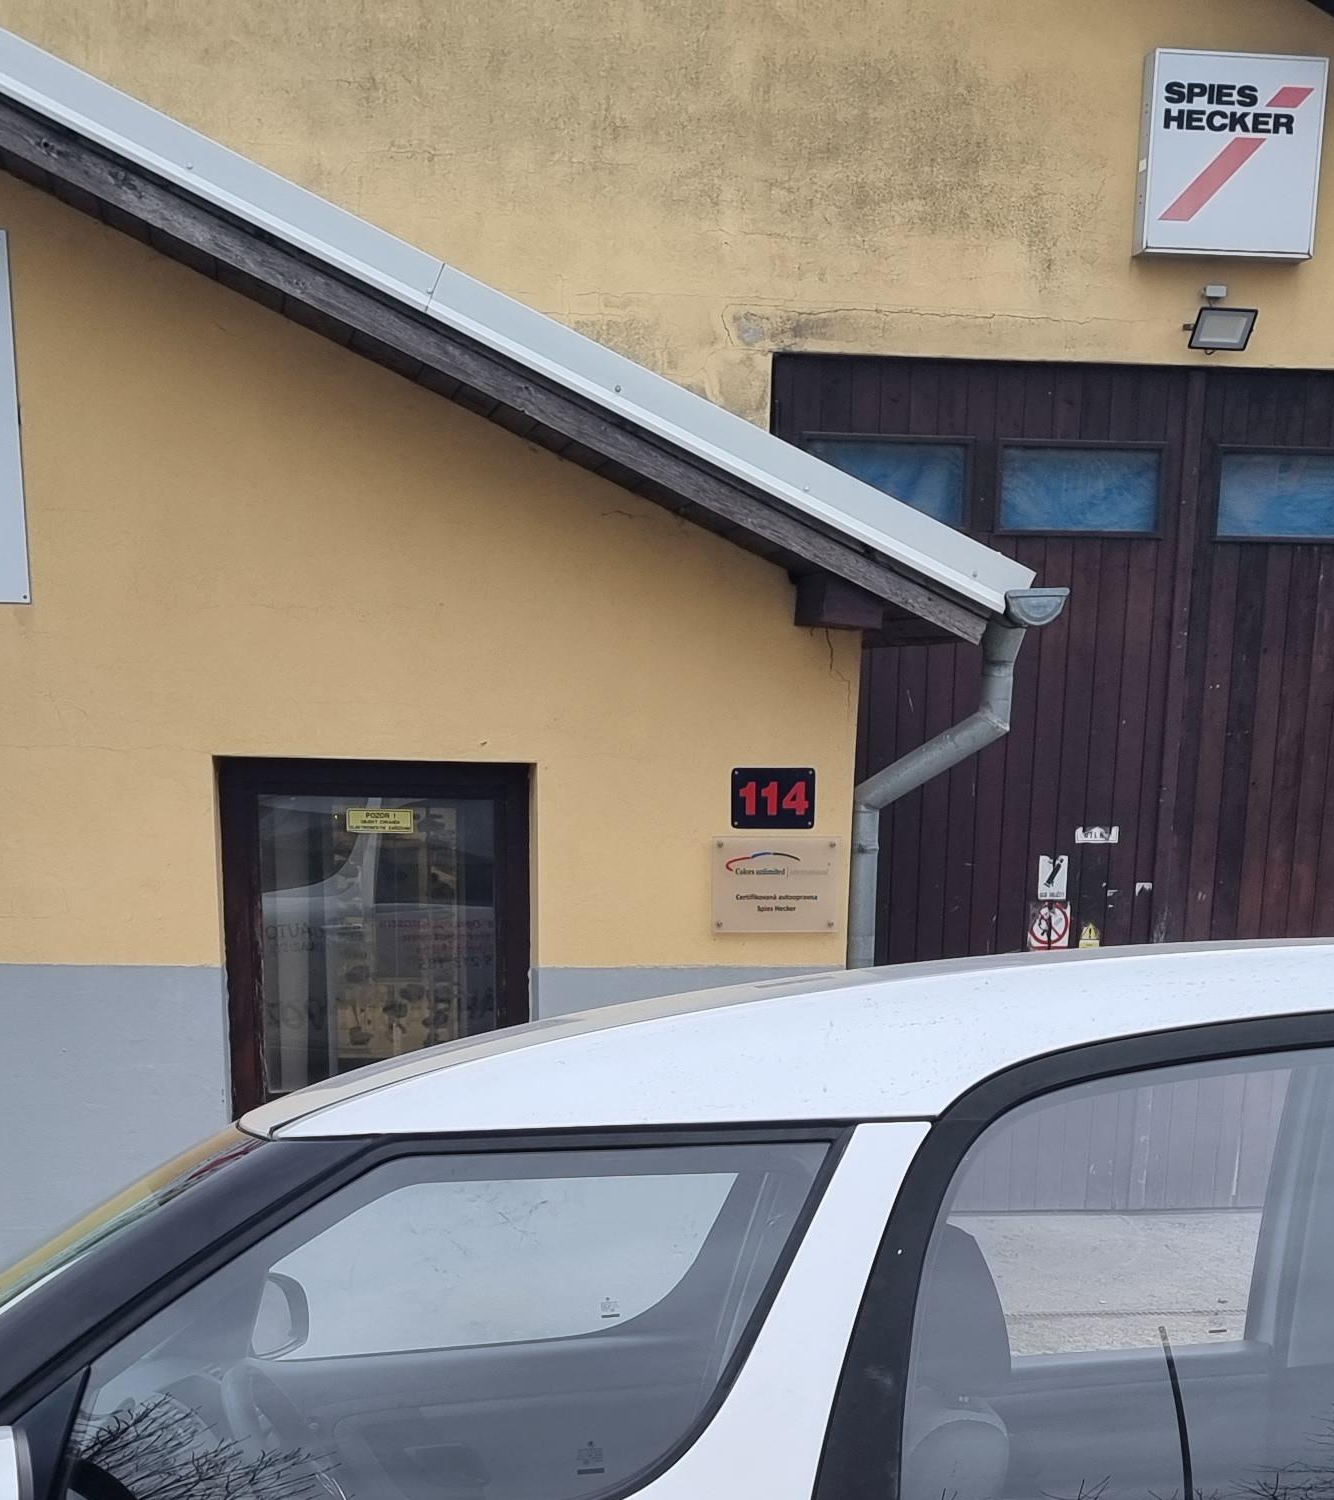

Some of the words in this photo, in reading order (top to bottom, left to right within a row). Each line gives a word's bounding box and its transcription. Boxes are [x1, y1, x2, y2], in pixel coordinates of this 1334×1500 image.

[1164, 81, 1259, 108] SPIES
[1163, 108, 1295, 135] HECKER
[739, 781, 809, 816] 114
